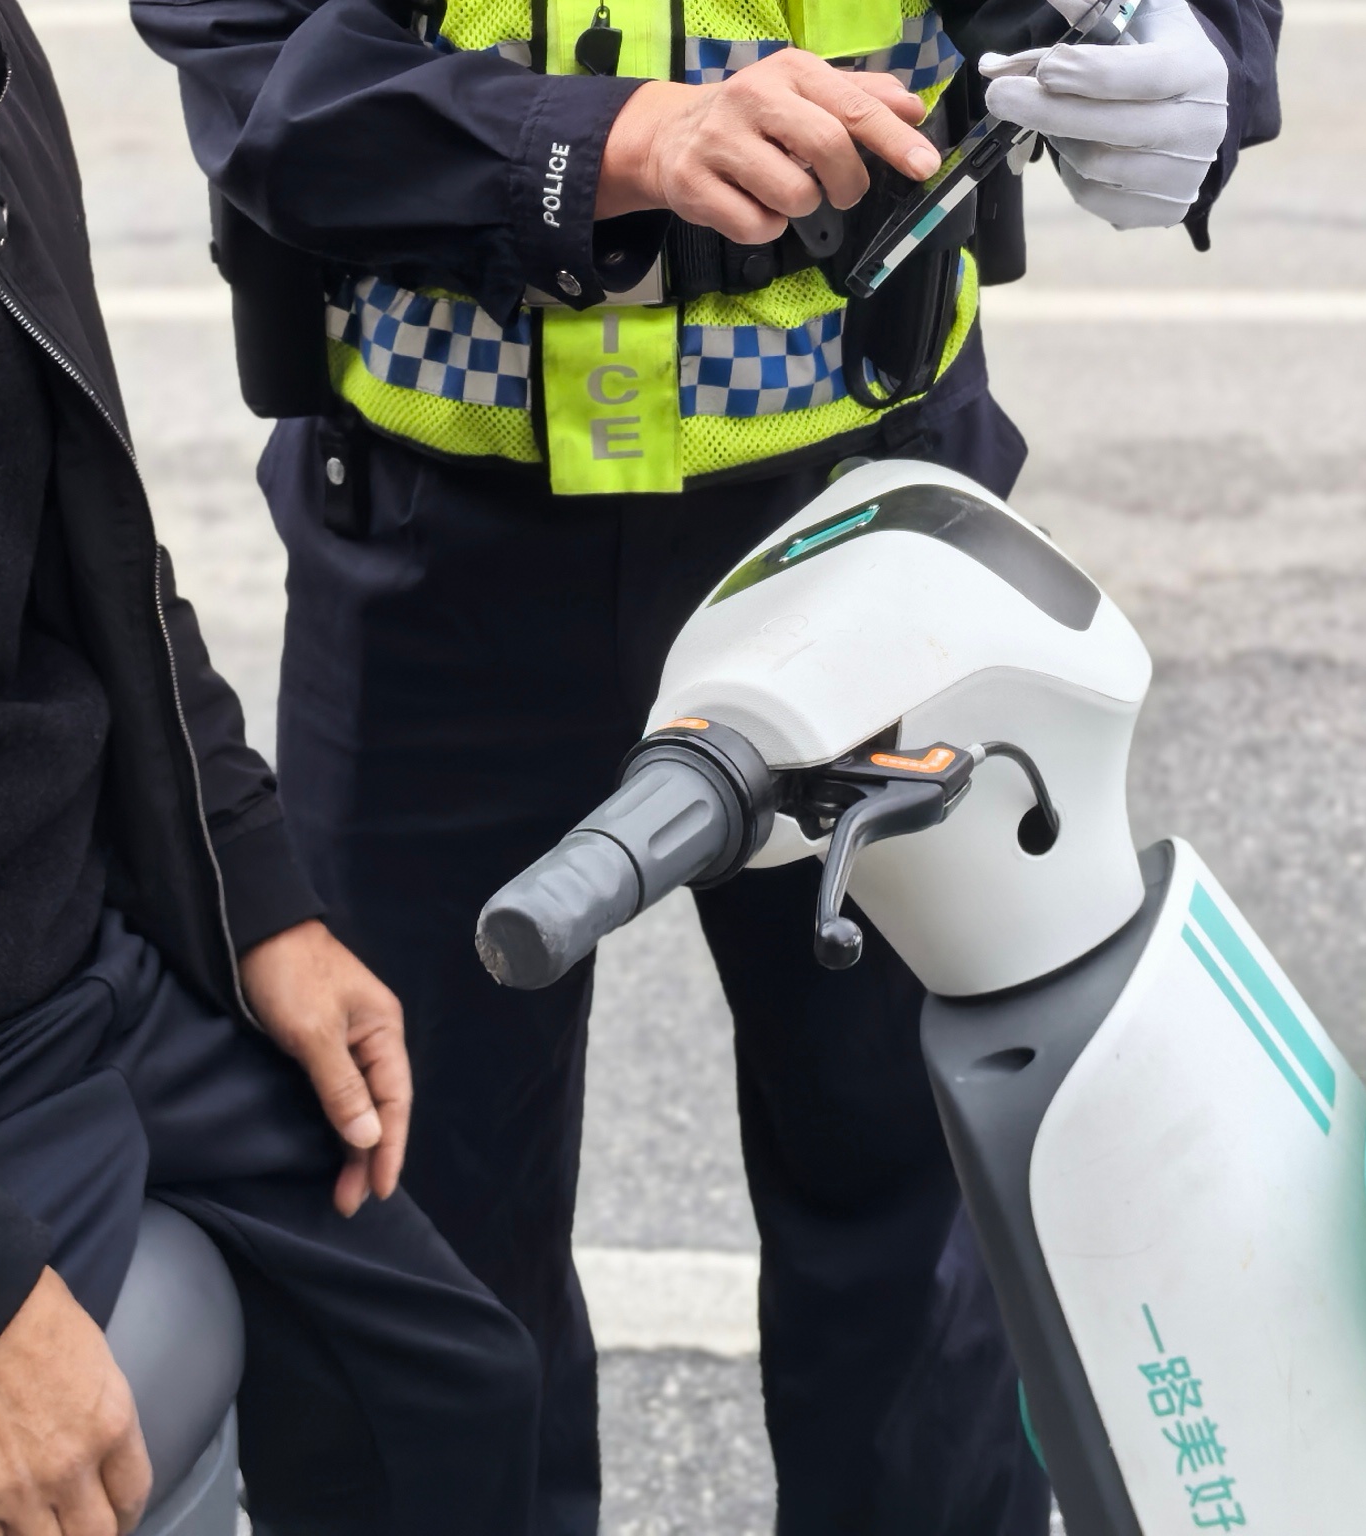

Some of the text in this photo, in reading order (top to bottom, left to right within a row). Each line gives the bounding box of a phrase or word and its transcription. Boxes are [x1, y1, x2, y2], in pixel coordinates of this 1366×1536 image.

[543, 142, 570, 229] POLICE
[1136, 1302, 1247, 1533] 一路美好
